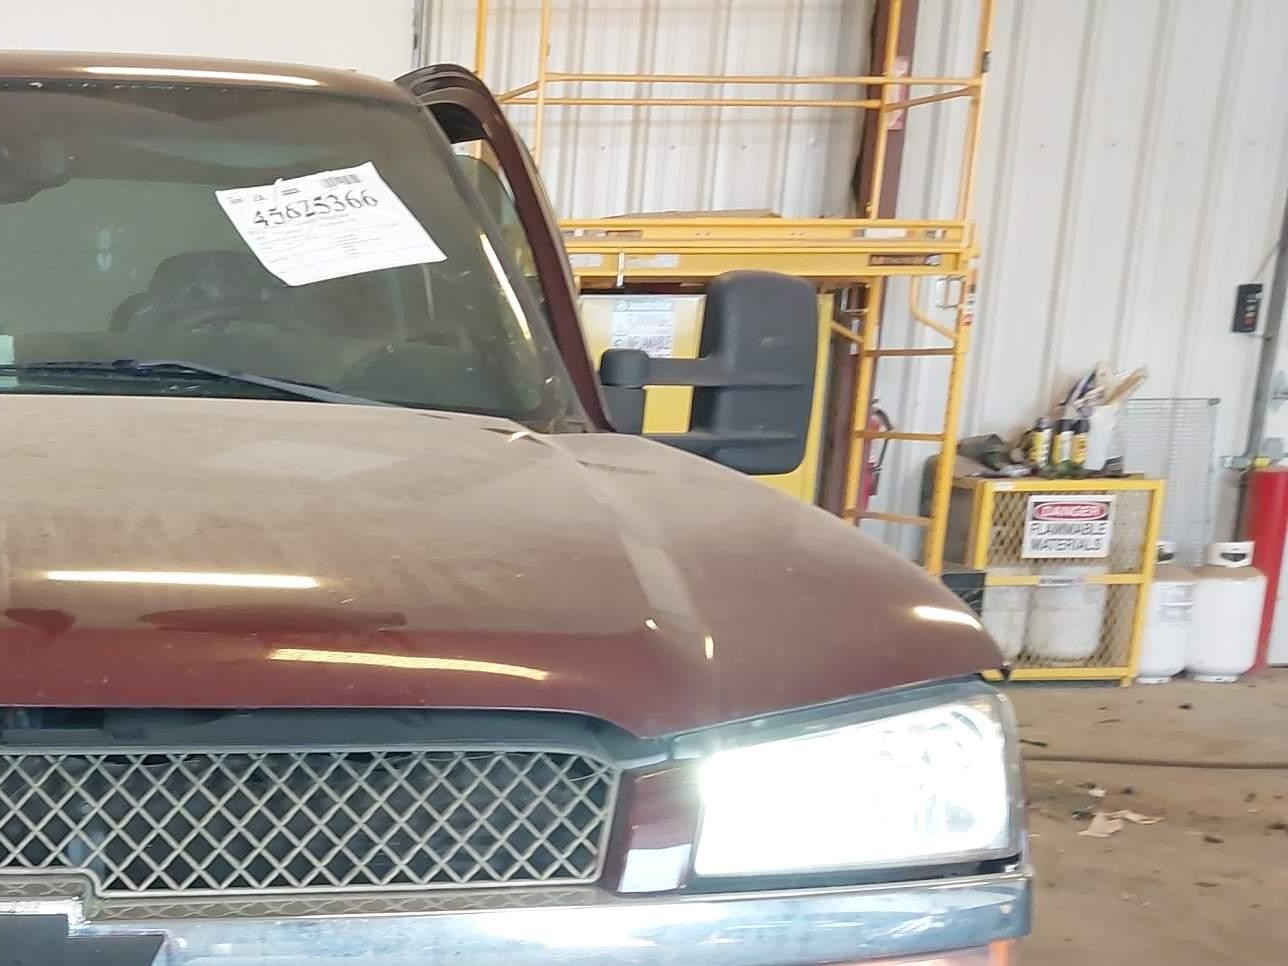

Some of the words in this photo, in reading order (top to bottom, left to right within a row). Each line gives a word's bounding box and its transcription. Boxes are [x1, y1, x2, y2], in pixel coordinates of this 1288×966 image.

[253, 189, 378, 226] 45625366
[1040, 505, 1102, 517] DANGER
[1031, 522, 1107, 536] FLAMMABLE
[1030, 538, 1102, 551] MATERIALS
